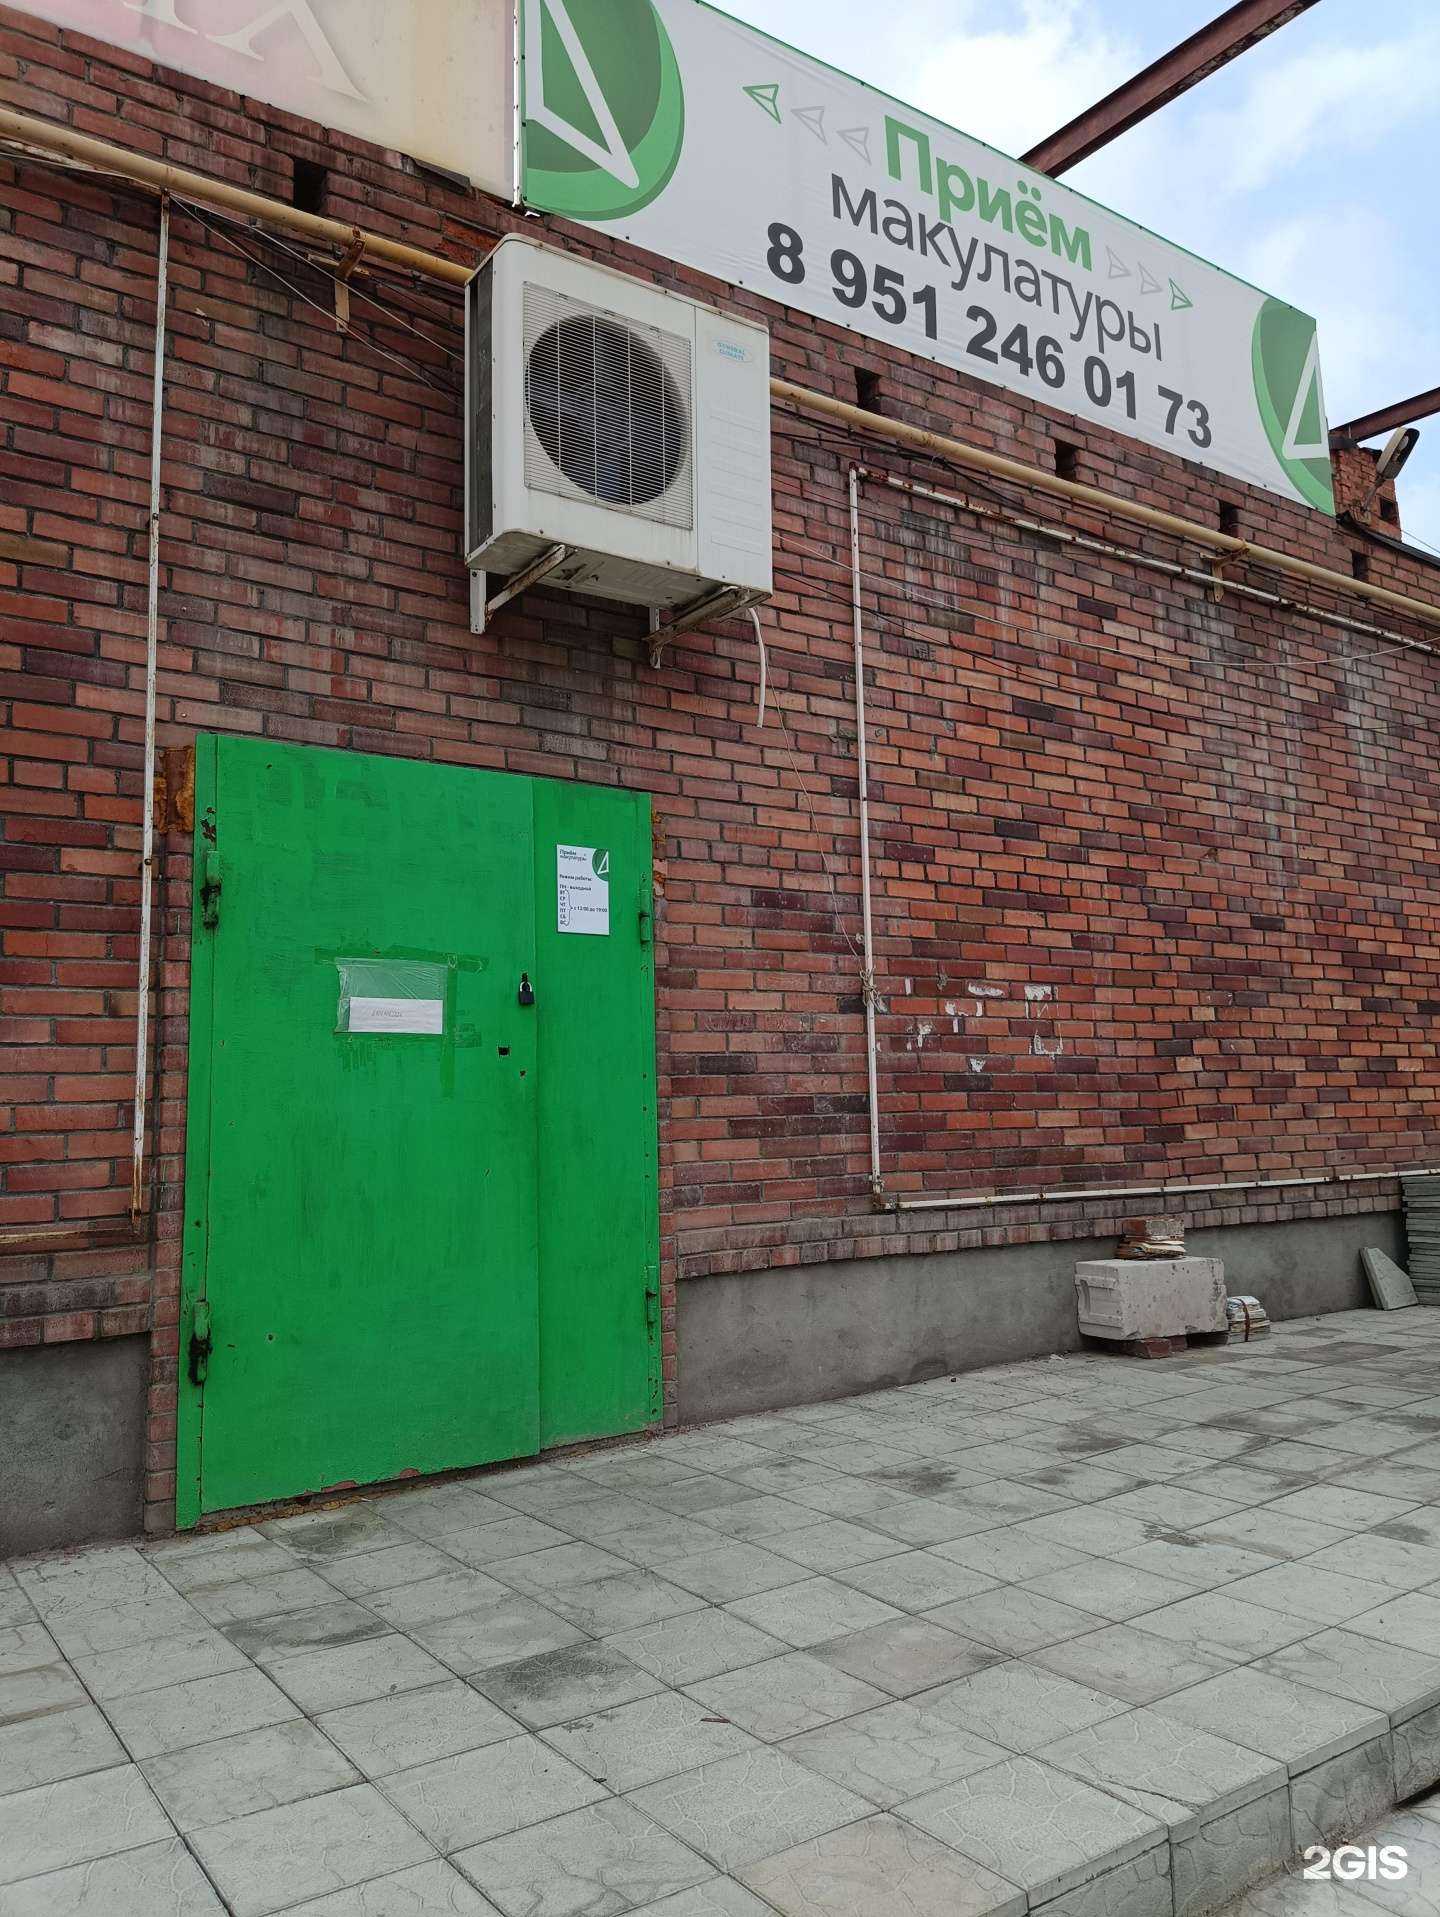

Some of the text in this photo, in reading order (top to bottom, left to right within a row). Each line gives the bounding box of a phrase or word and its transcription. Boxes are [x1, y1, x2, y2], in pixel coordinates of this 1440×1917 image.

[831, 173, 1163, 361] макулатуры
[884, 115, 1092, 271] Приём
[766, 223, 1212, 449] 8 951 246 01 73
